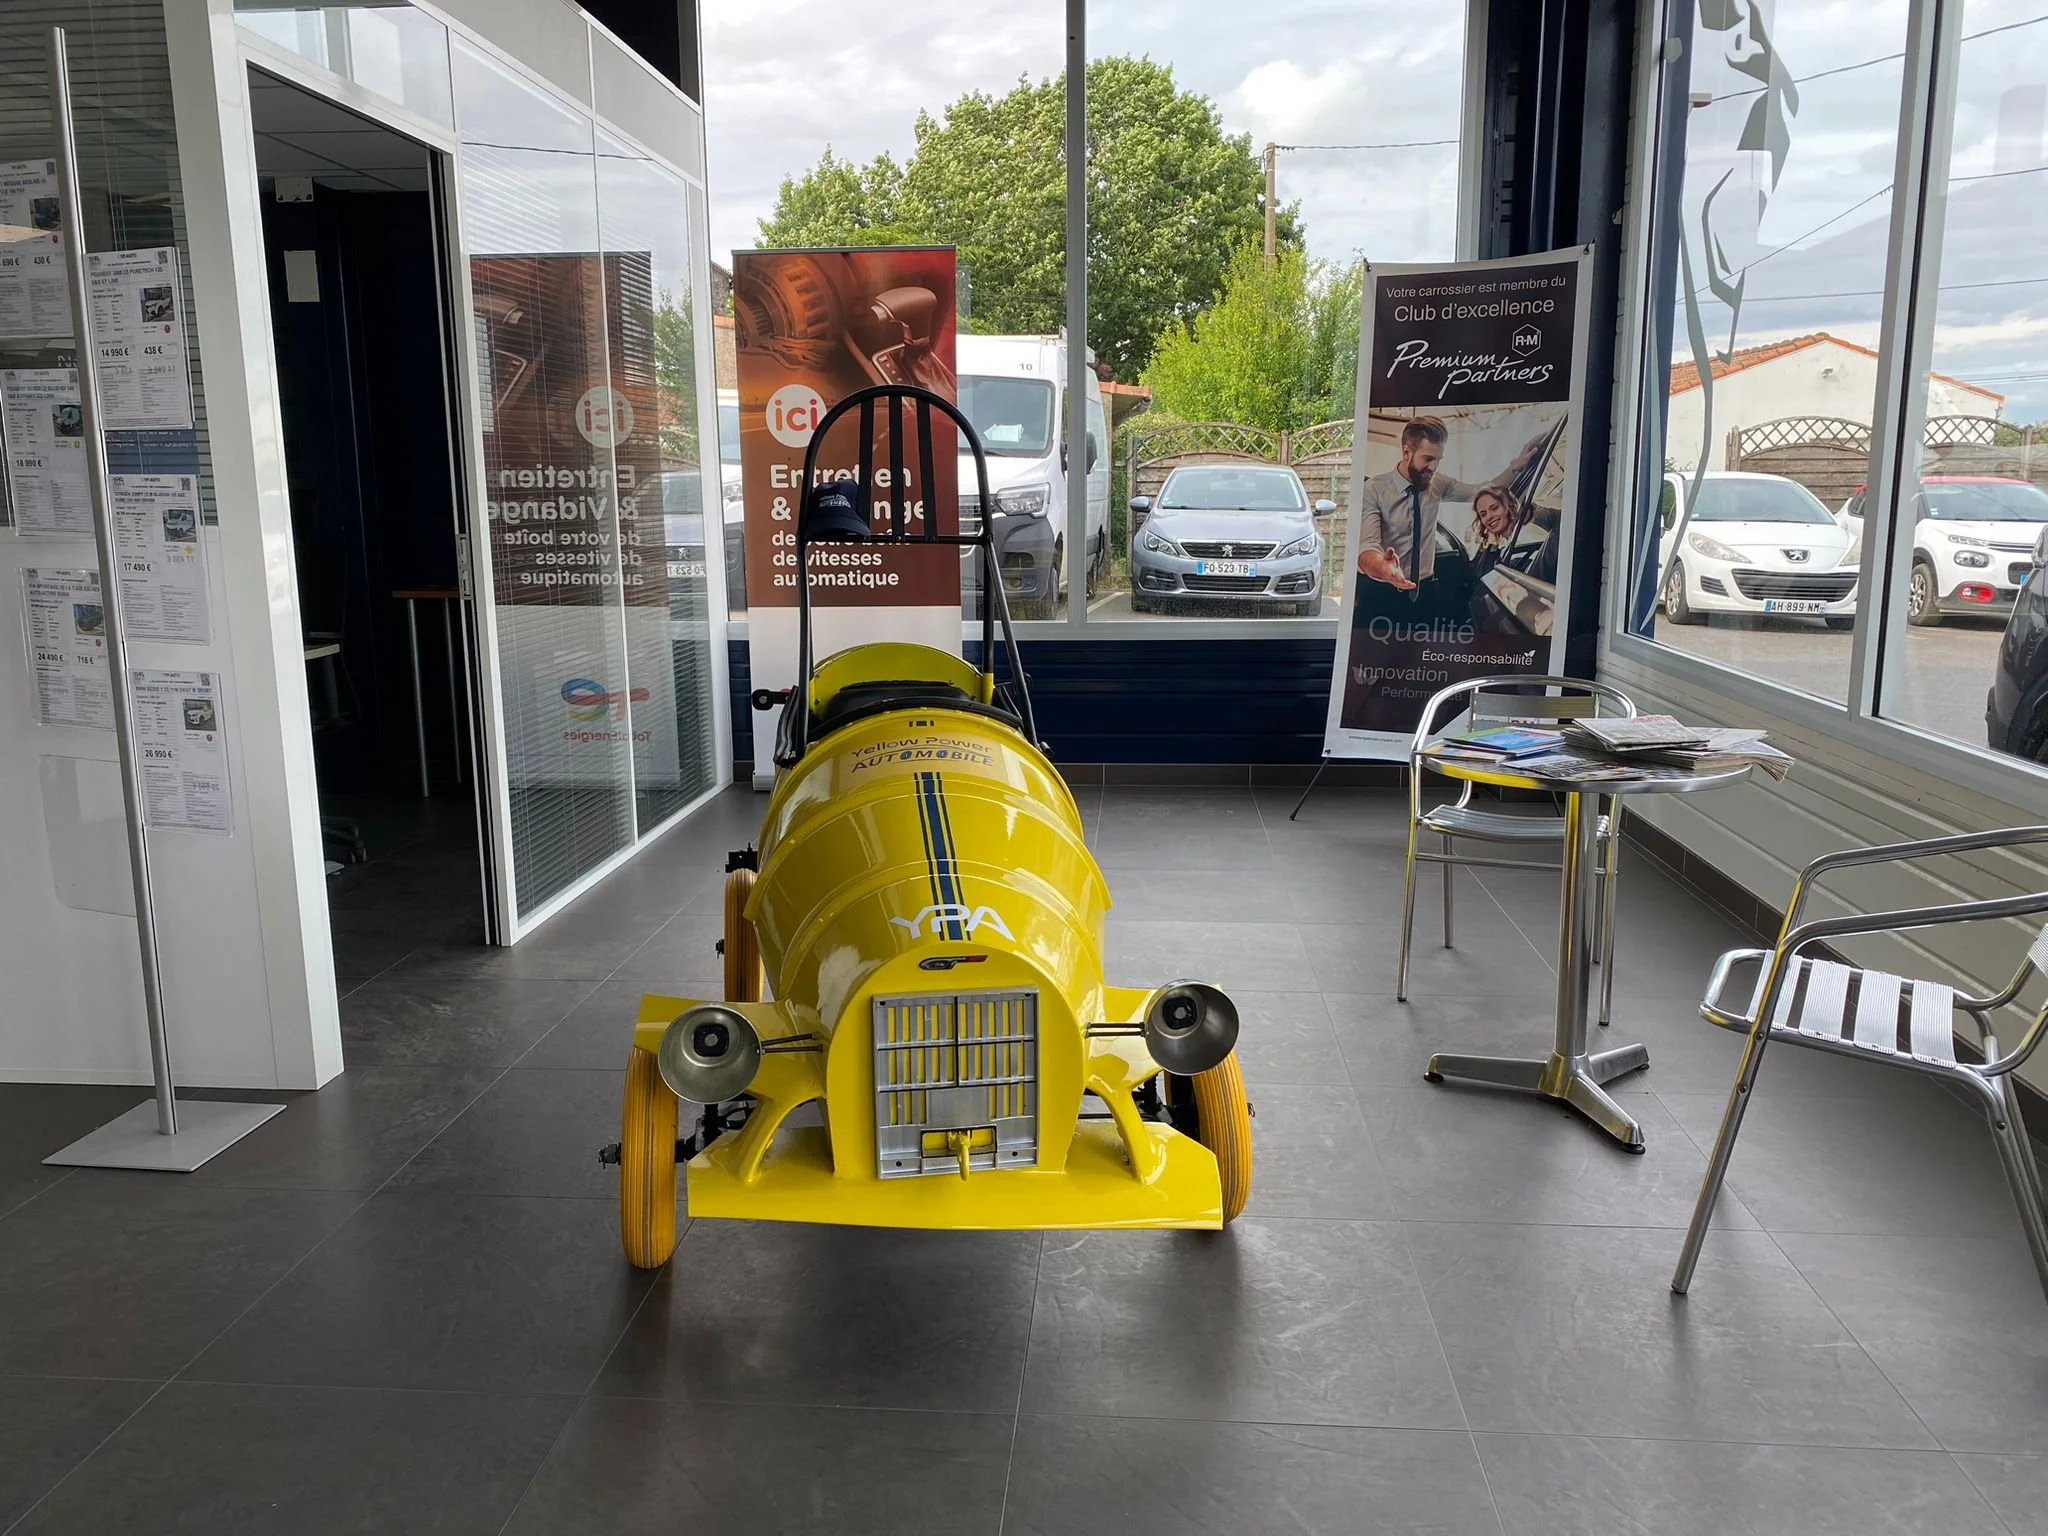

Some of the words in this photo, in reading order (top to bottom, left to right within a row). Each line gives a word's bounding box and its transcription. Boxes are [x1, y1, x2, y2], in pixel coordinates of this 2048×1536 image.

[1386, 287, 1416, 298] Votre
[1419, 284, 1475, 297] carrossier
[1478, 283, 1496, 293] est
[1499, 278, 1548, 292] membre
[1550, 275, 1566, 287] du
[1394, 304, 1436, 322] Club
[1441, 298, 1555, 320] d'excellence
[101, 349, 110, 358] 14
[110, 348, 123, 357] 990
[144, 347, 156, 355] 438
[1387, 339, 1497, 379] Premium
[1018, 363, 1033, 371] 10
[1437, 356, 1554, 400] partners
[774, 398, 818, 432] ici
[26, 459, 37, 467] 990
[770, 464, 912, 489] Entreten
[770, 496, 792, 521] &
[771, 530, 797, 547] de
[124, 563, 132, 571] 17
[133, 563, 145, 572] 490
[772, 550, 798, 566] de
[806, 550, 882, 567] vitesses
[773, 570, 900, 589] auomatique
[1368, 615, 1476, 645] Qualité
[38, 652, 47, 661] 24
[1357, 663, 1449, 683] Innovation
[1381, 686, 1464, 702] Performce
[145, 750, 154, 758] 26
[154, 750, 166, 759] 990
[852, 738, 919, 758] Yellow
[925, 736, 992, 753] Power
[851, 749, 994, 773] AUTOMOBILE
[888, 903, 1017, 942] YPA
